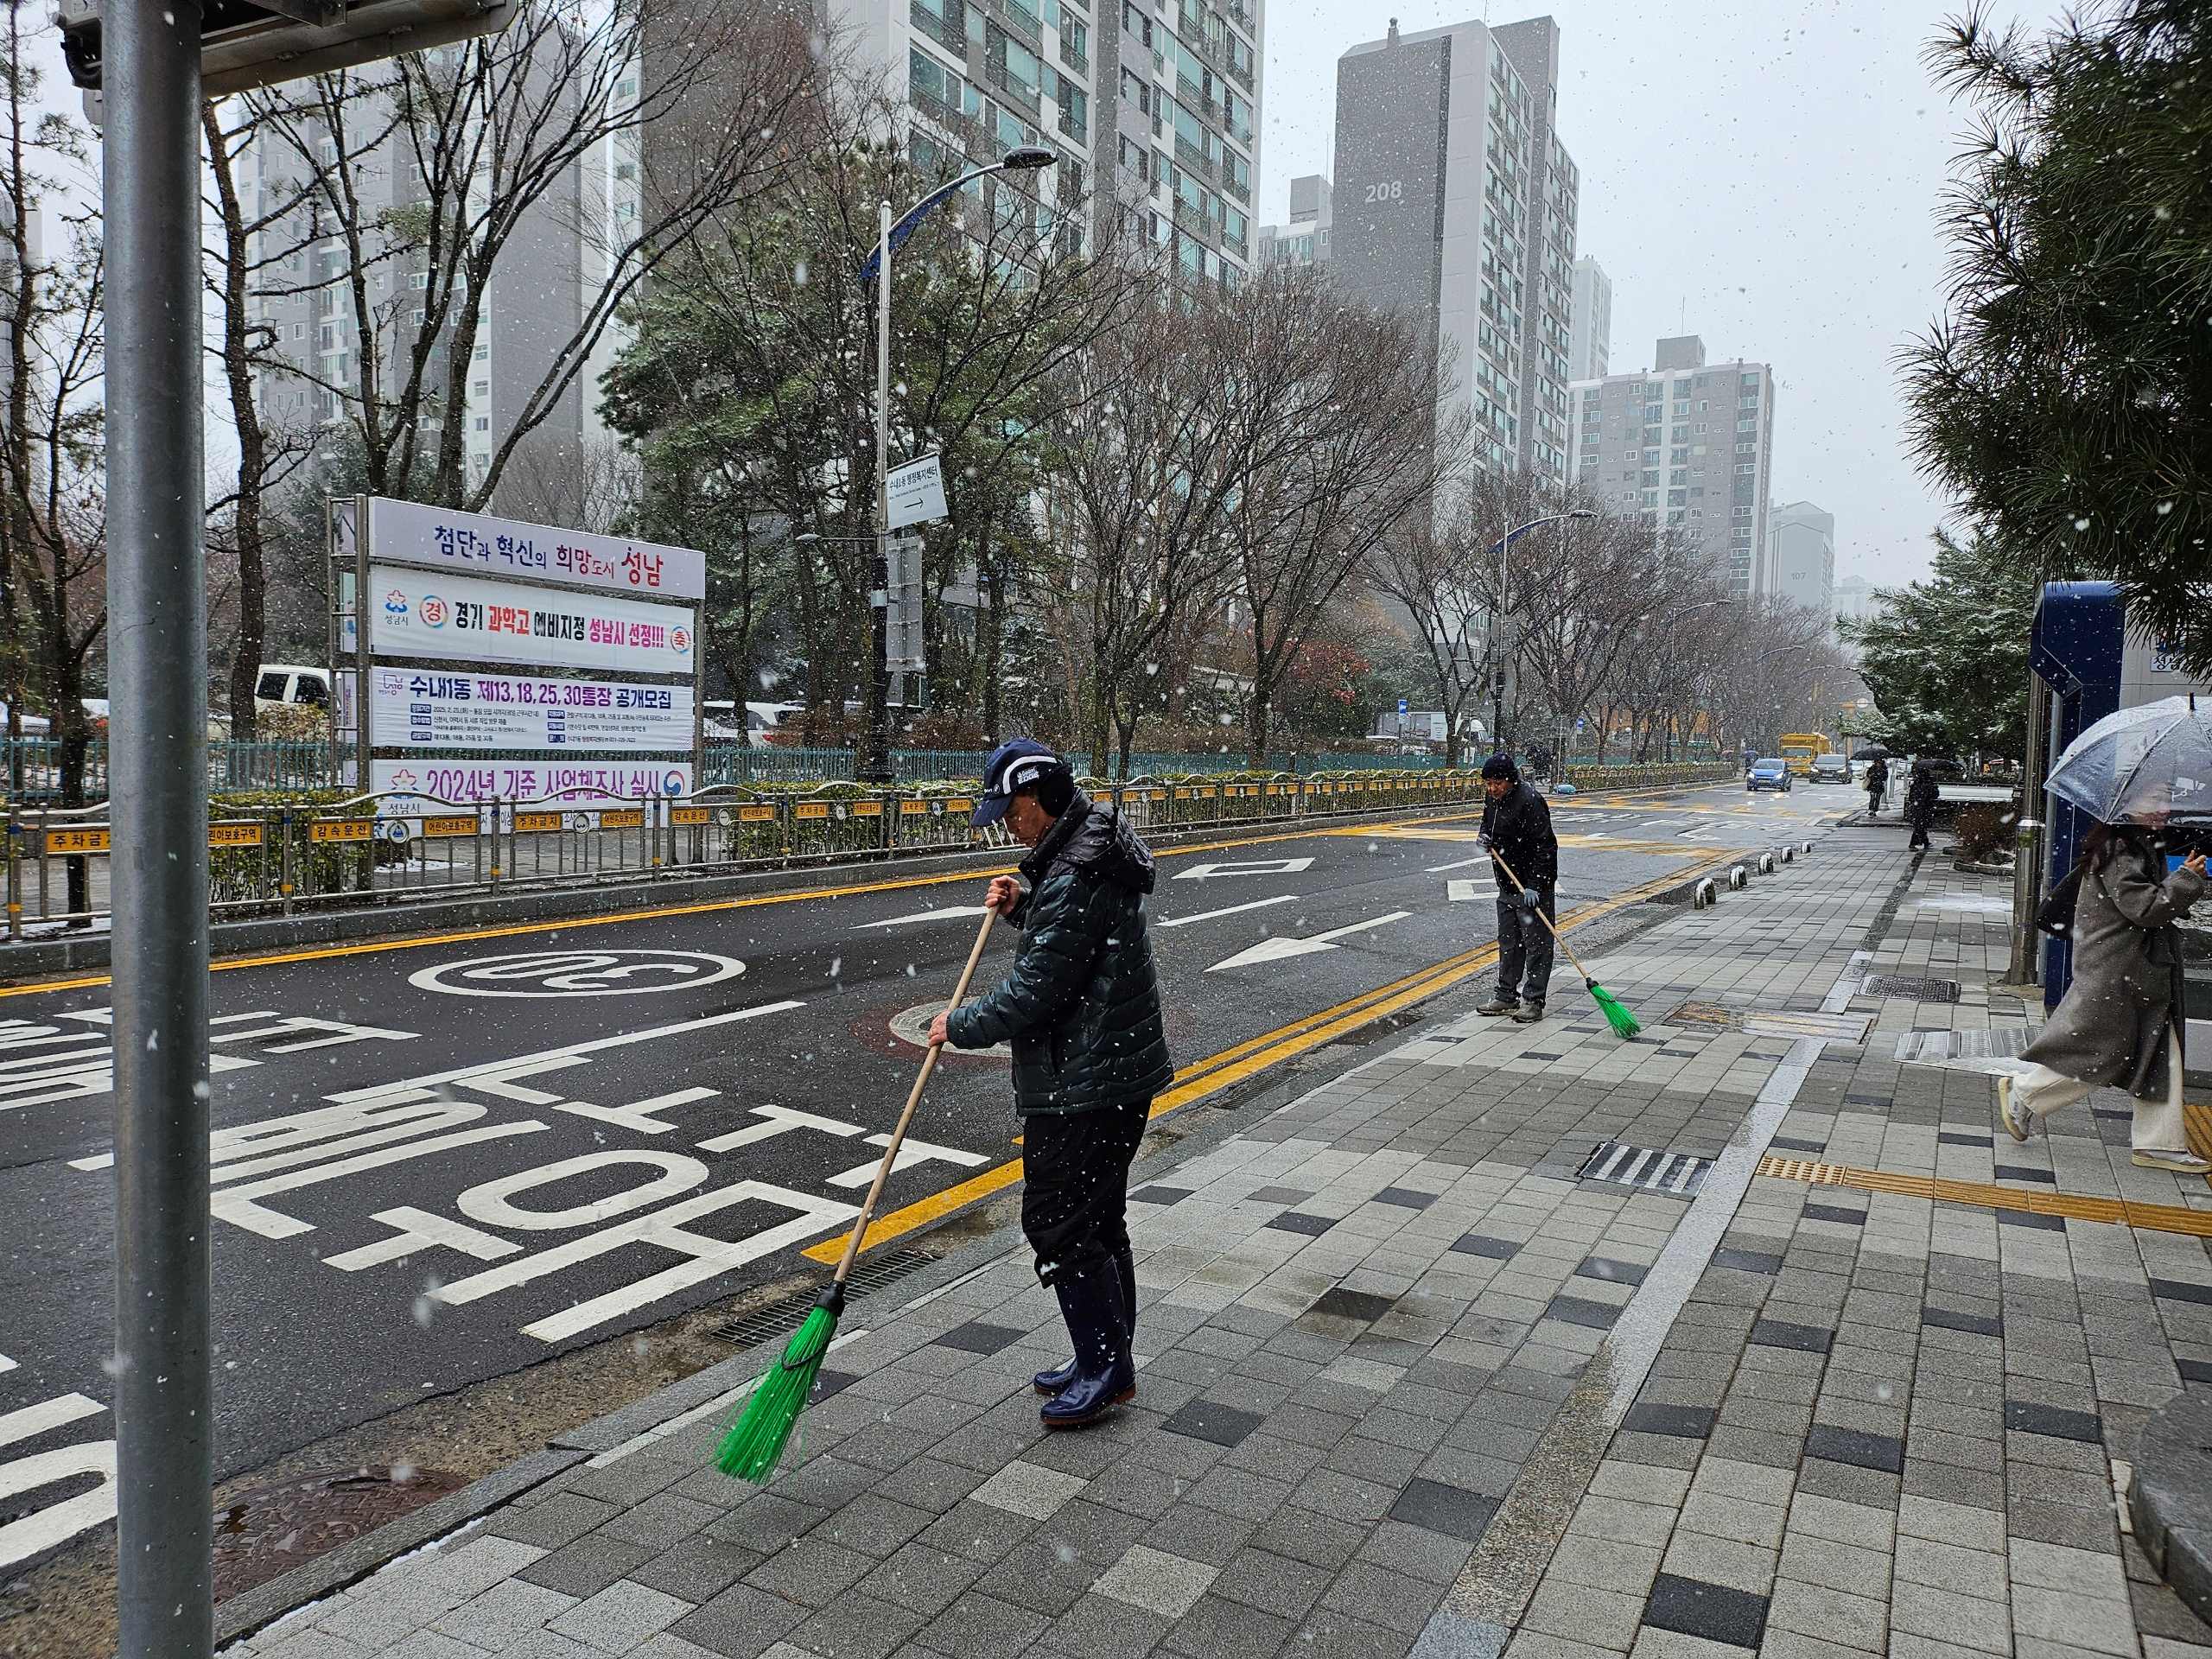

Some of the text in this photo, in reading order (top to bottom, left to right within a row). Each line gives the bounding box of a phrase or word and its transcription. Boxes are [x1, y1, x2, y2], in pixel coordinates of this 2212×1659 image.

[1365, 181, 1402, 203] 208
[435, 524, 664, 587] 첨단과 혁신의 희망도시 성남
[384, 614, 409, 626] 성남시
[454, 601, 664, 648] 경기 과학고 예비지정 성남시 선정!!!
[409, 676, 472, 702] 수내1동
[616, 688, 671, 709] 공개모집
[427, 769, 659, 802] 2024년 기준 사업체조사 실시
[388, 803, 421, 816] 성남시
[429, 821, 473, 831] 어린이보호구역
[518, 815, 557, 827] 주차금지
[208, 829, 257, 841] 린이보호구역
[461, 956, 698, 988] 30
